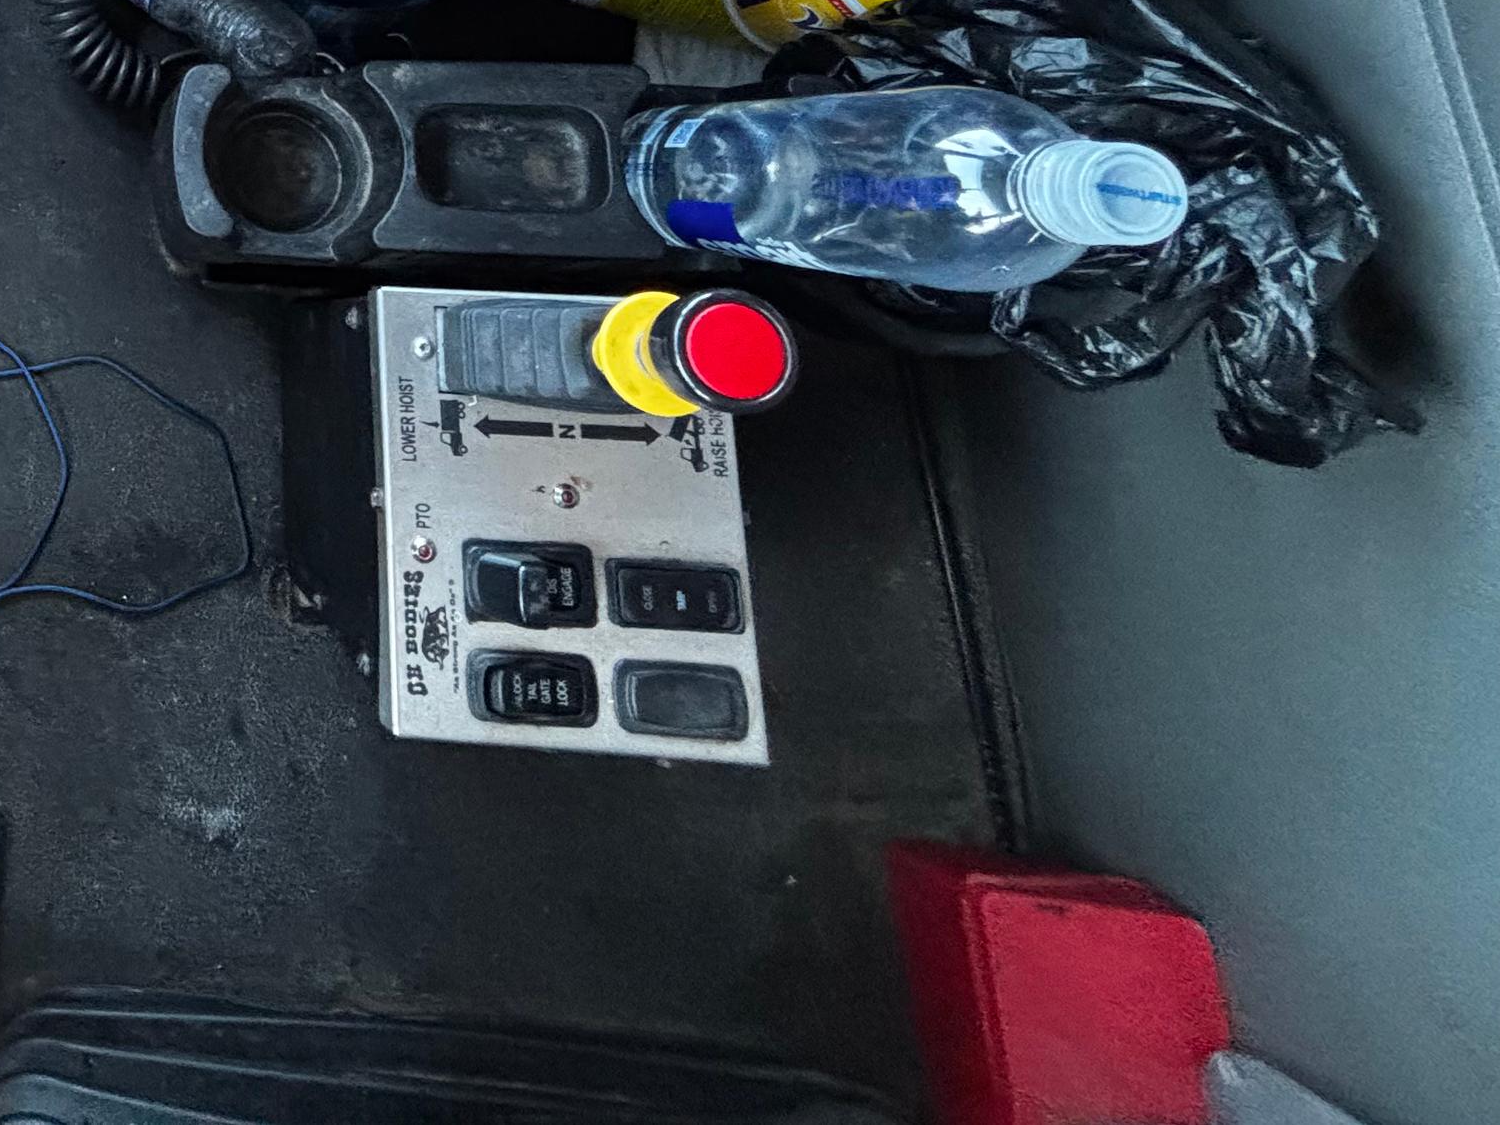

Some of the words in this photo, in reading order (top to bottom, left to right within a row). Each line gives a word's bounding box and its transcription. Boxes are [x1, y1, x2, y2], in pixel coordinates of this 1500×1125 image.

[399, 376, 416, 414] HOIST
[559, 425, 576, 439] N
[707, 409, 725, 436] HOI
[401, 416, 417, 462] LOWER
[711, 438, 729, 478] RAISE
[415, 503, 431, 529] PTO
[547, 578, 558, 594] DIS
[560, 567, 575, 607] ENGAGE
[403, 570, 424, 655] BODIES
[528, 681, 538, 700] TAIL
[540, 678, 552, 705] GATE
[556, 679, 569, 707] LOCK
